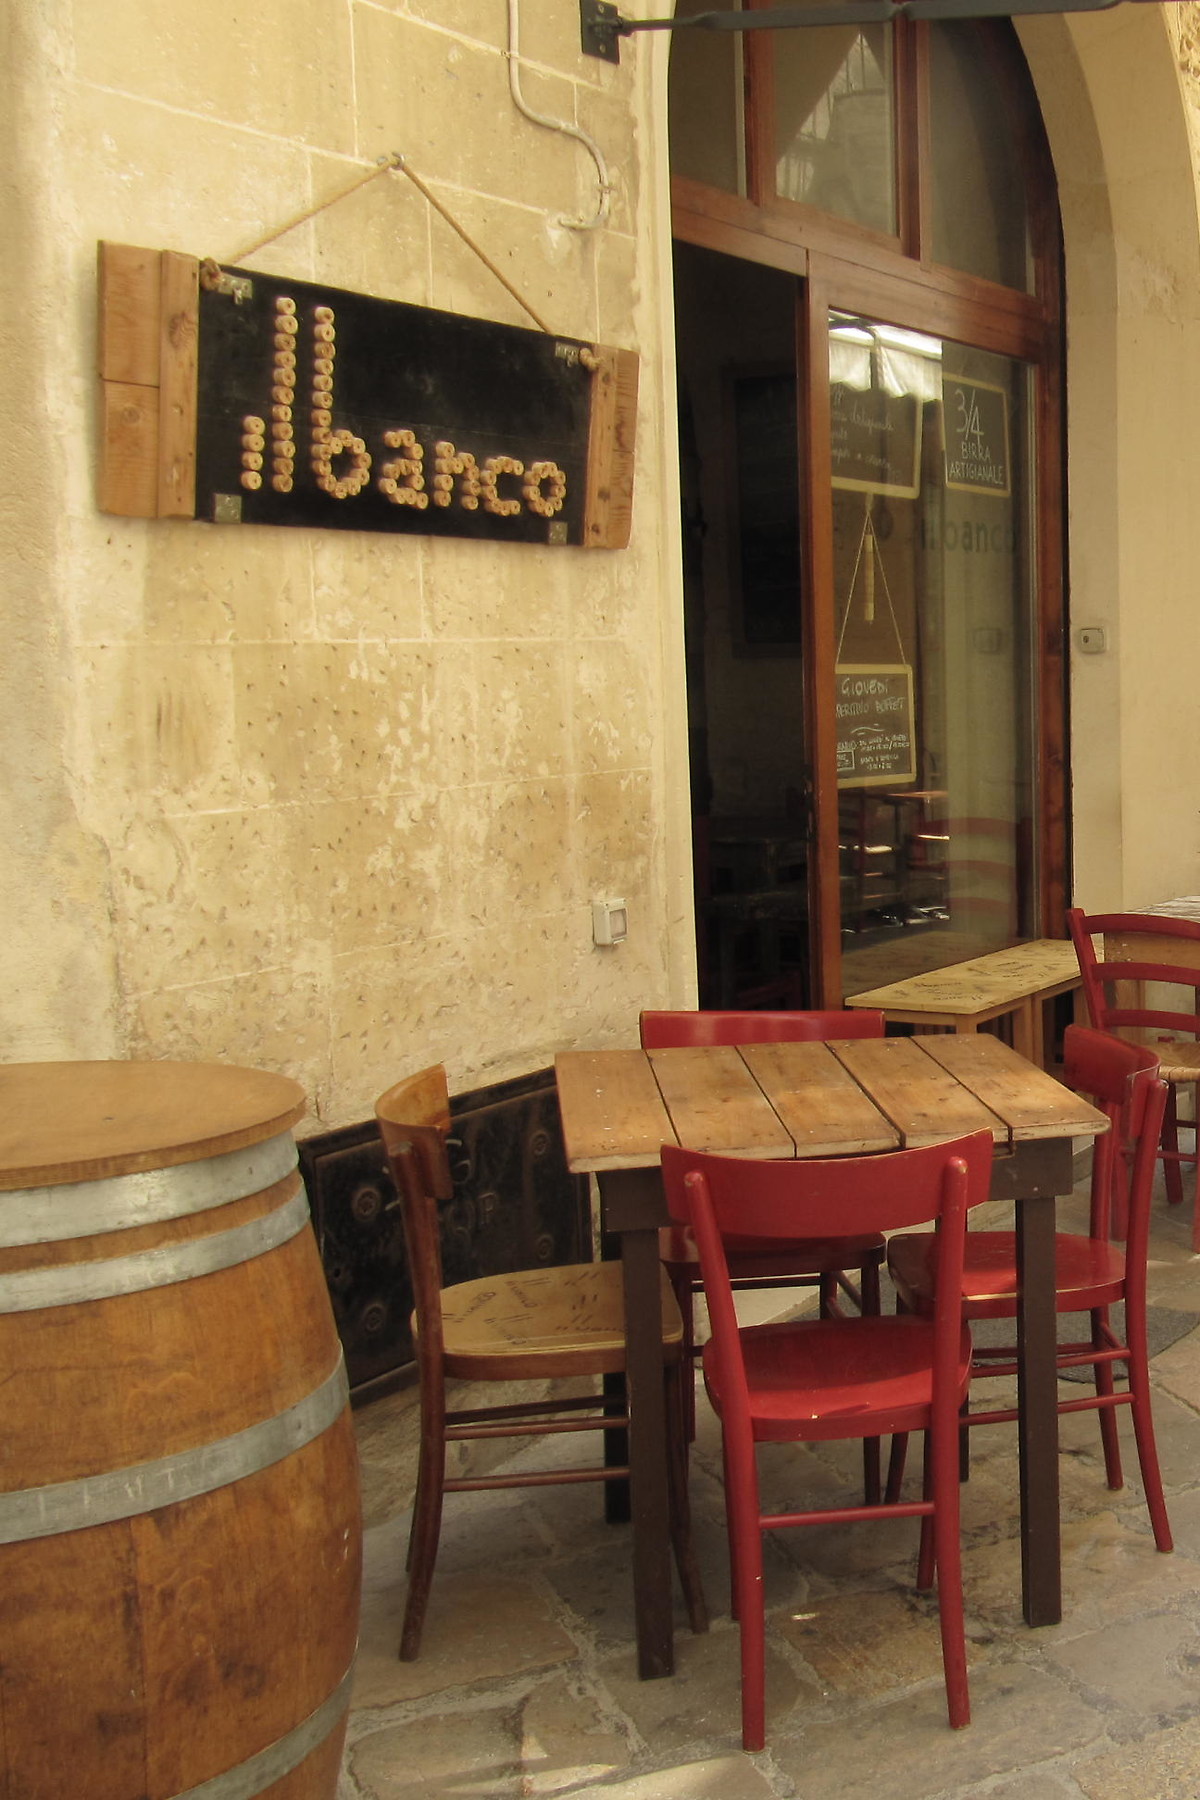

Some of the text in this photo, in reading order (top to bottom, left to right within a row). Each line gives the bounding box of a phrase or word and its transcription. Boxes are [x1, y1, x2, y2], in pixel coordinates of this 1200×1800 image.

[954, 388, 985, 442] 3/4
[961, 441, 992, 462] BIRRA
[949, 460, 1005, 485] ARTIGIANALE
